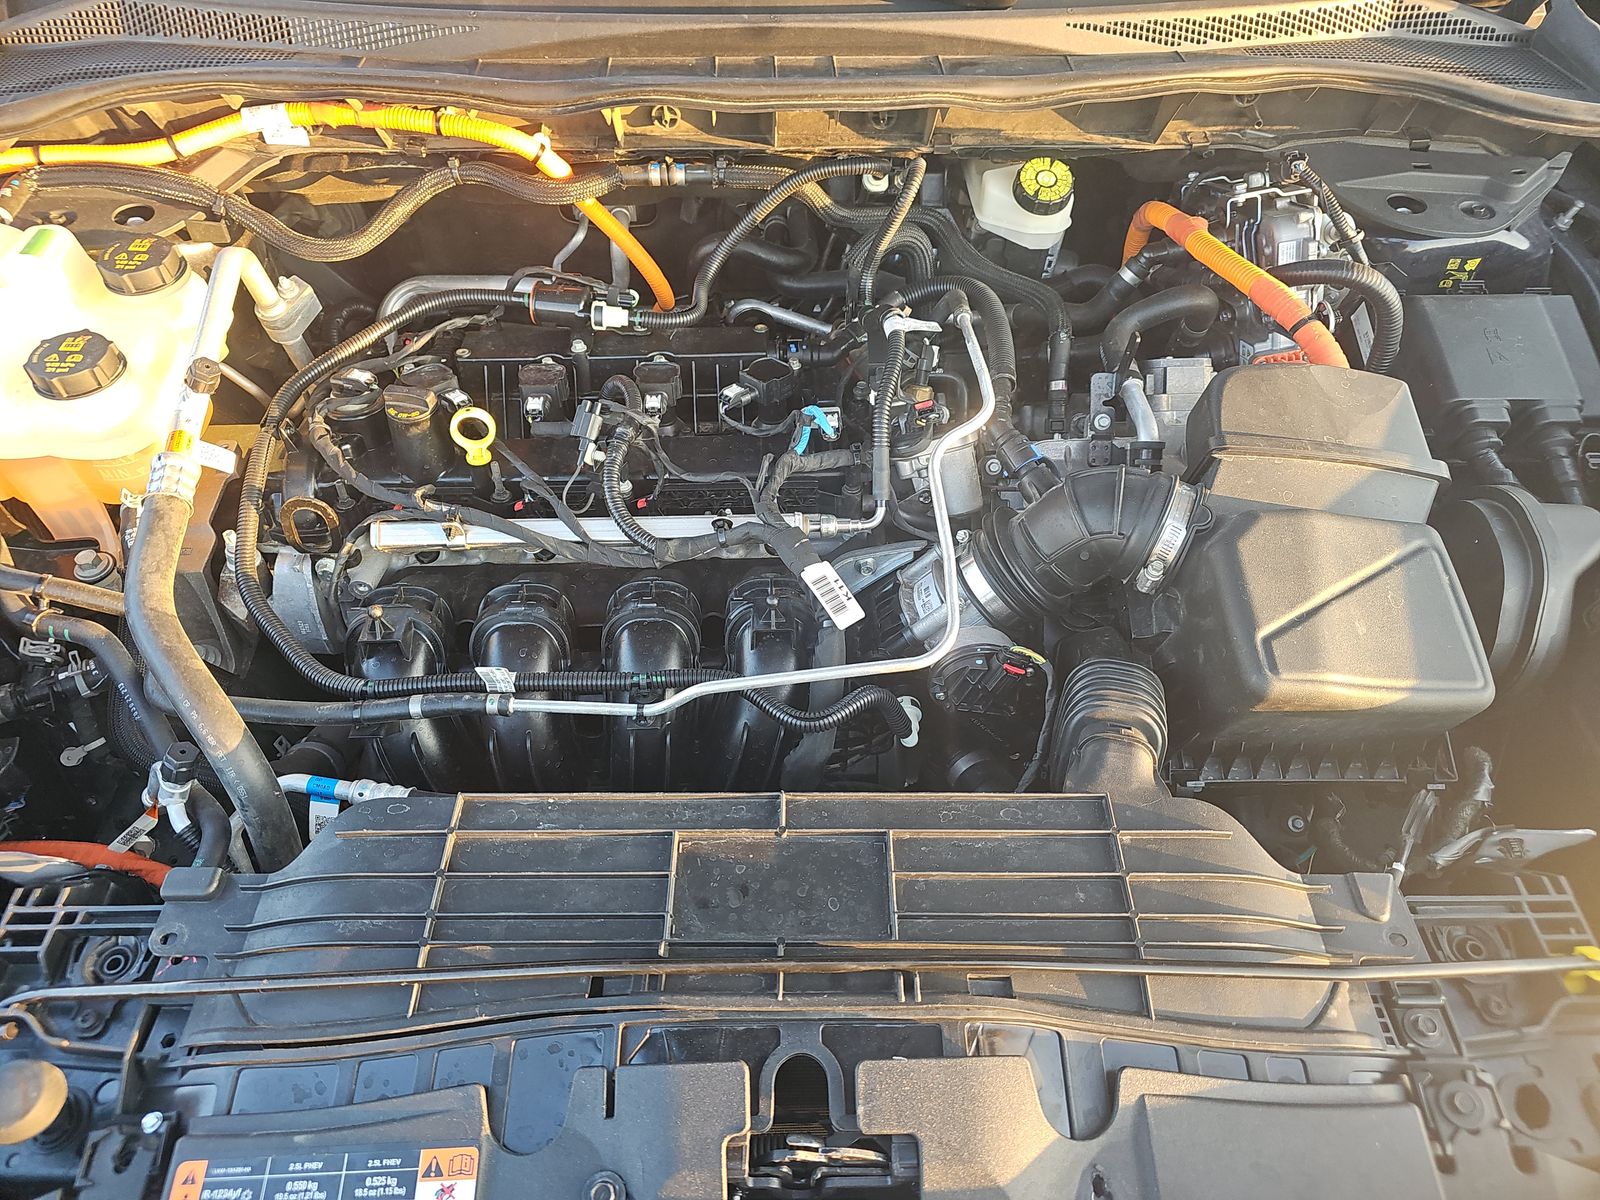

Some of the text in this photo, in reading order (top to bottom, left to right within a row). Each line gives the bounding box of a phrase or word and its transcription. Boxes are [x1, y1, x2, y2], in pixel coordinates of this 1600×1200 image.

[833, 578, 853, 601] K11
[367, 1160, 382, 1168] 2.5L
[307, 1180, 319, 1191] kg
[387, 1176, 398, 1186] kg
